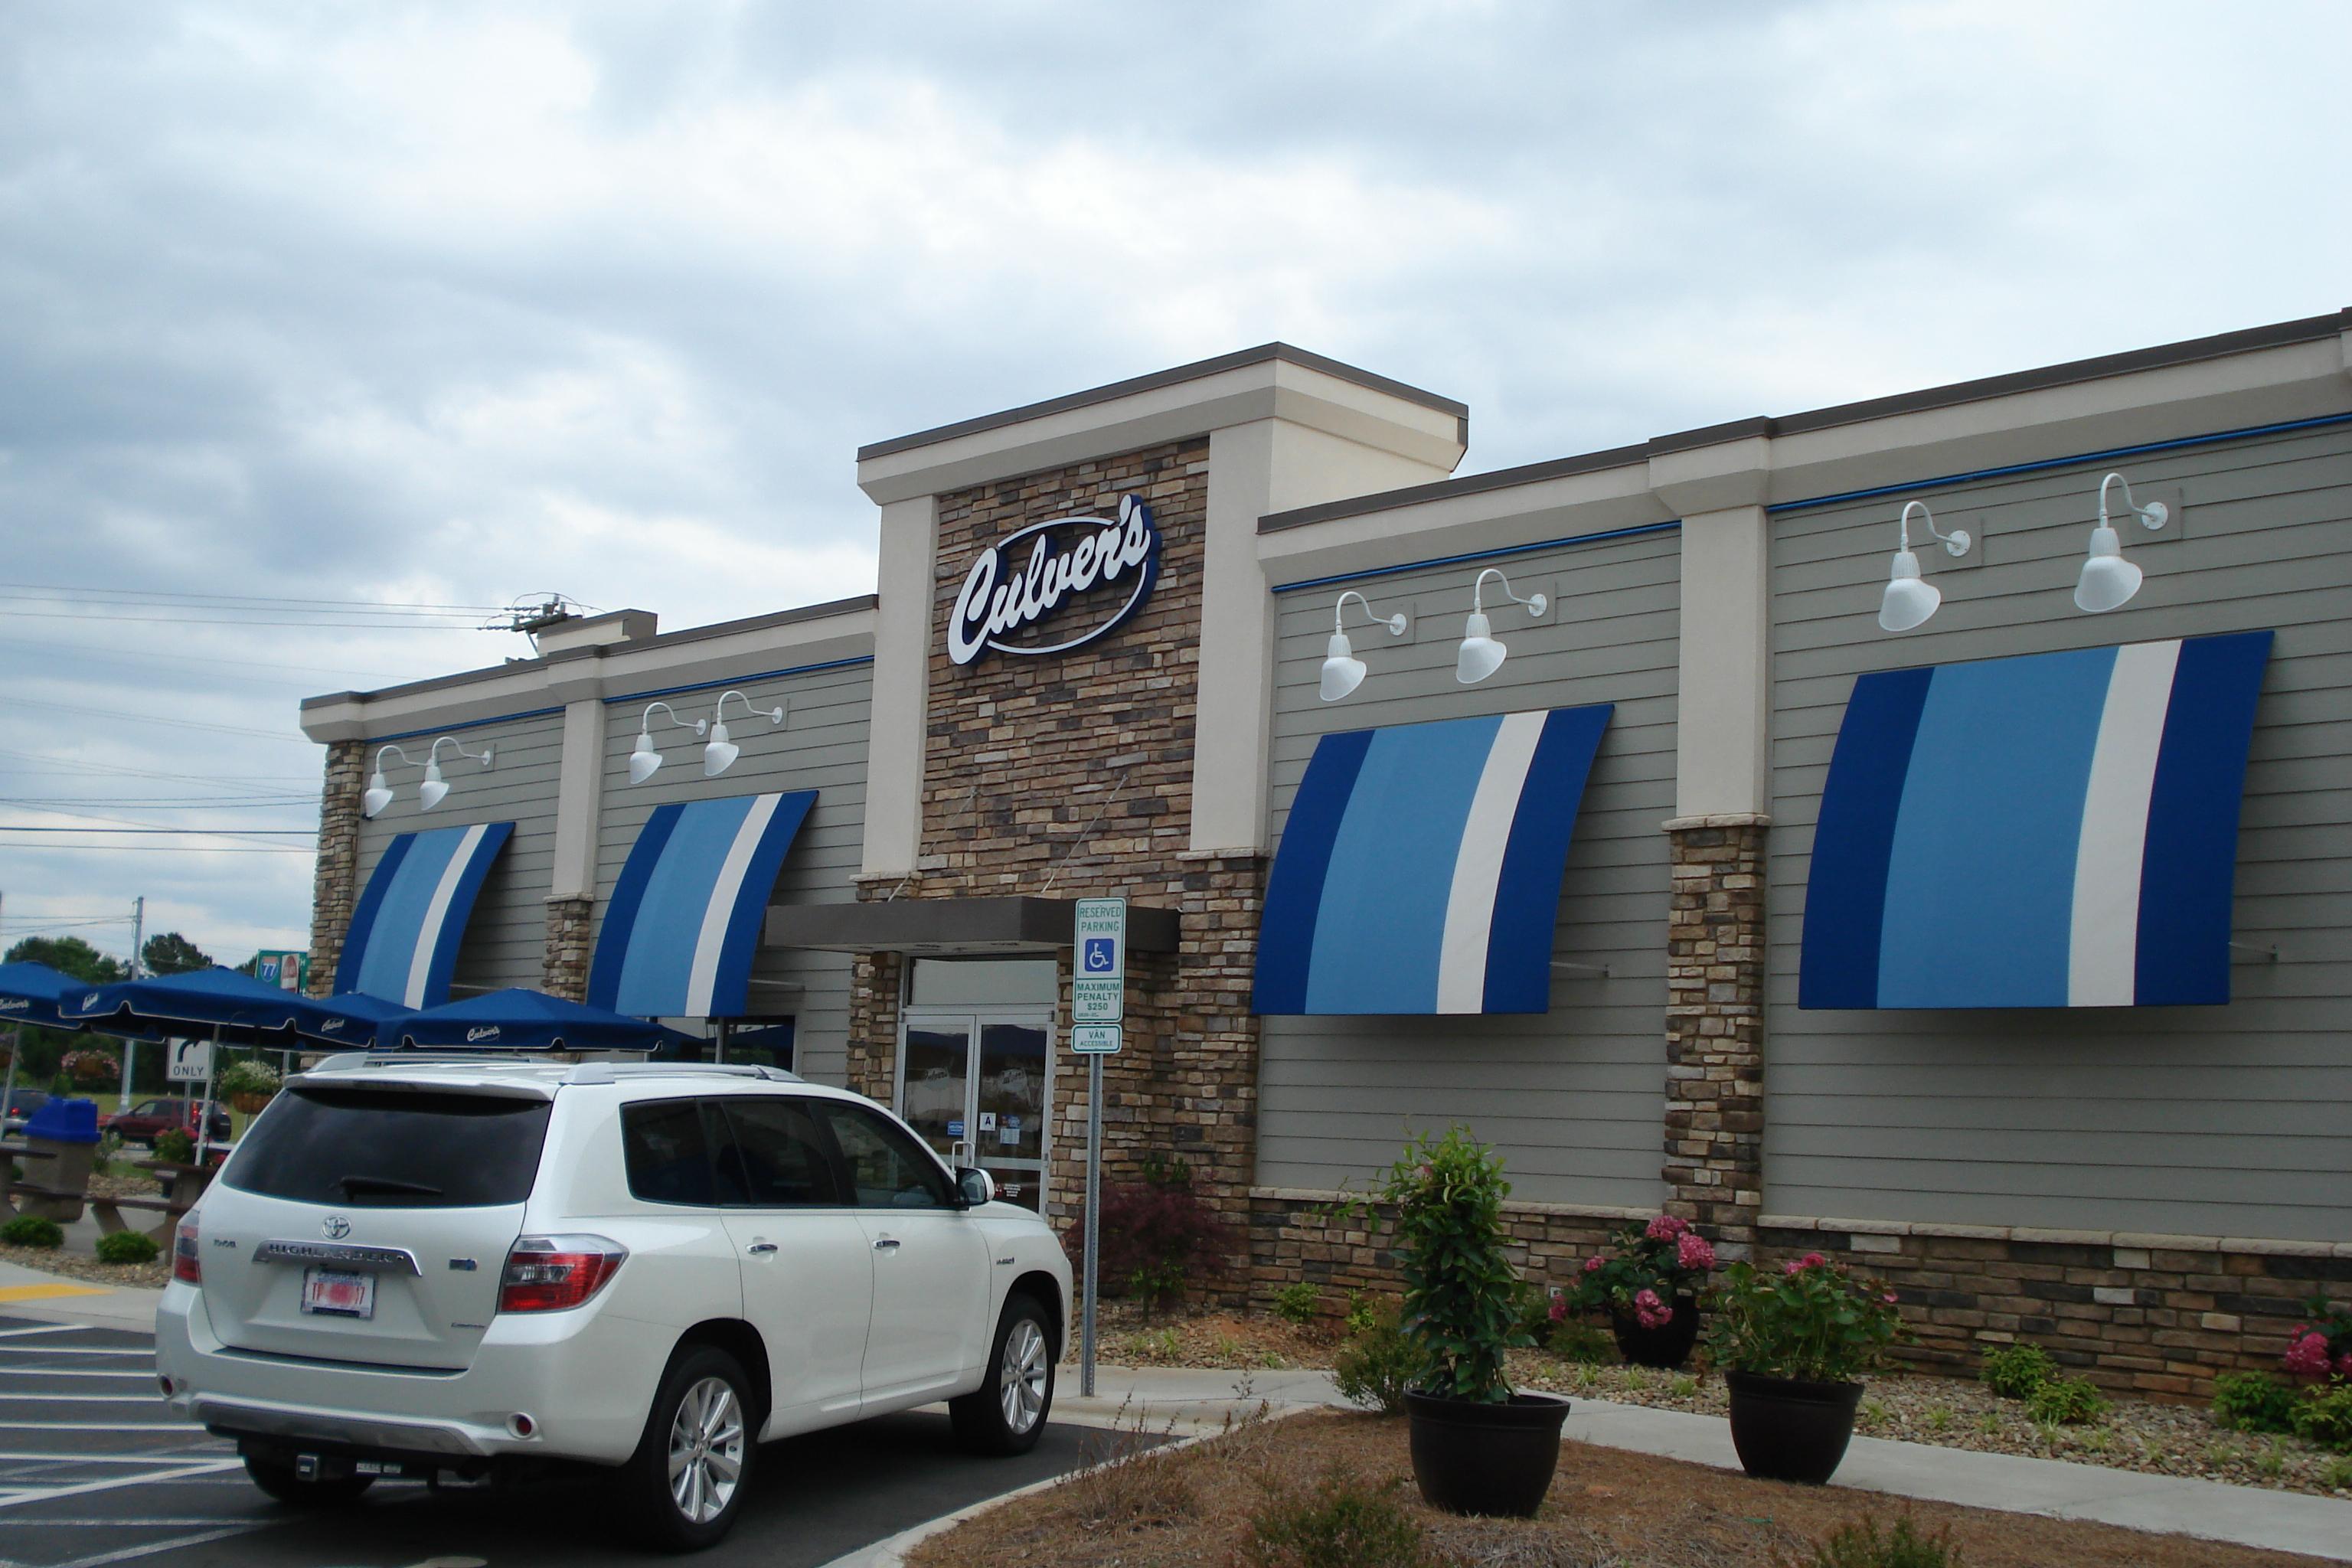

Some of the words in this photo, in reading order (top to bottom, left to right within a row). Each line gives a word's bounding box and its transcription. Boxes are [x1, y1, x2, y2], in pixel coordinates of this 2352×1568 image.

[947, 493, 1152, 665] Culver's
[1079, 906, 1122, 919] RESERVED
[1080, 920, 1120, 933] PARKING
[263, 963, 277, 978] 77
[1076, 982, 1120, 991] MAXIMUM
[1076, 992, 1119, 1001] PENALTY
[1086, 1001, 1108, 1011] $250
[466, 1025, 501, 1042] Culver's
[1088, 1031, 1106, 1040] VAN
[173, 1065, 204, 1077] ONLY
[985, 1116, 991, 1126] A
[268, 1243, 393, 1263] HIGHLANDER
